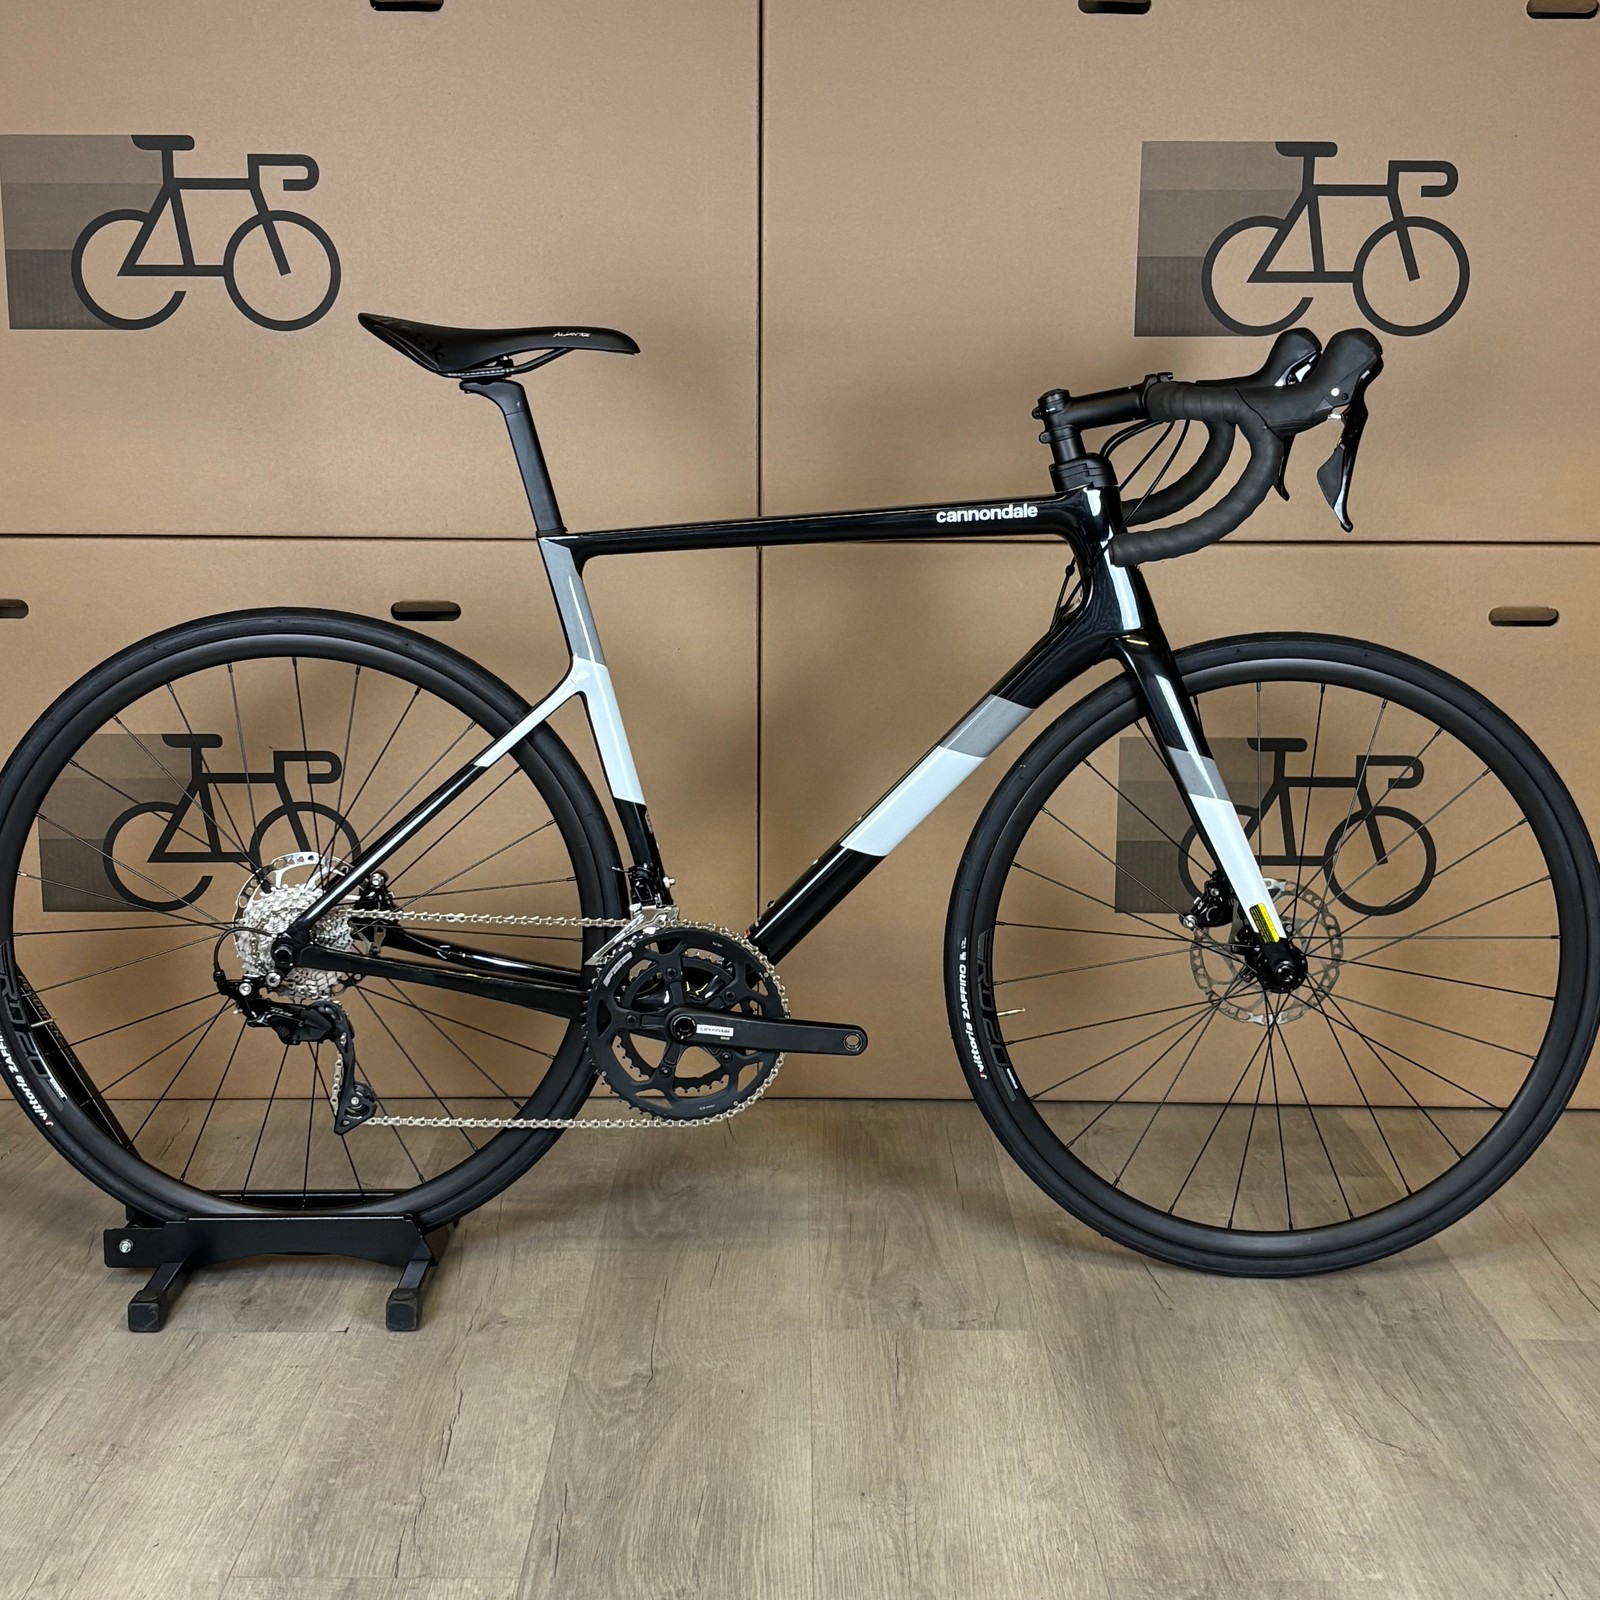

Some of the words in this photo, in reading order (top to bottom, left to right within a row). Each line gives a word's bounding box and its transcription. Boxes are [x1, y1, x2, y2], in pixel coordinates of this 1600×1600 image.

[936, 503, 1038, 523] cannondale
[965, 1021, 985, 1073] vittoria
[15, 1074, 49, 1121] vittoria
